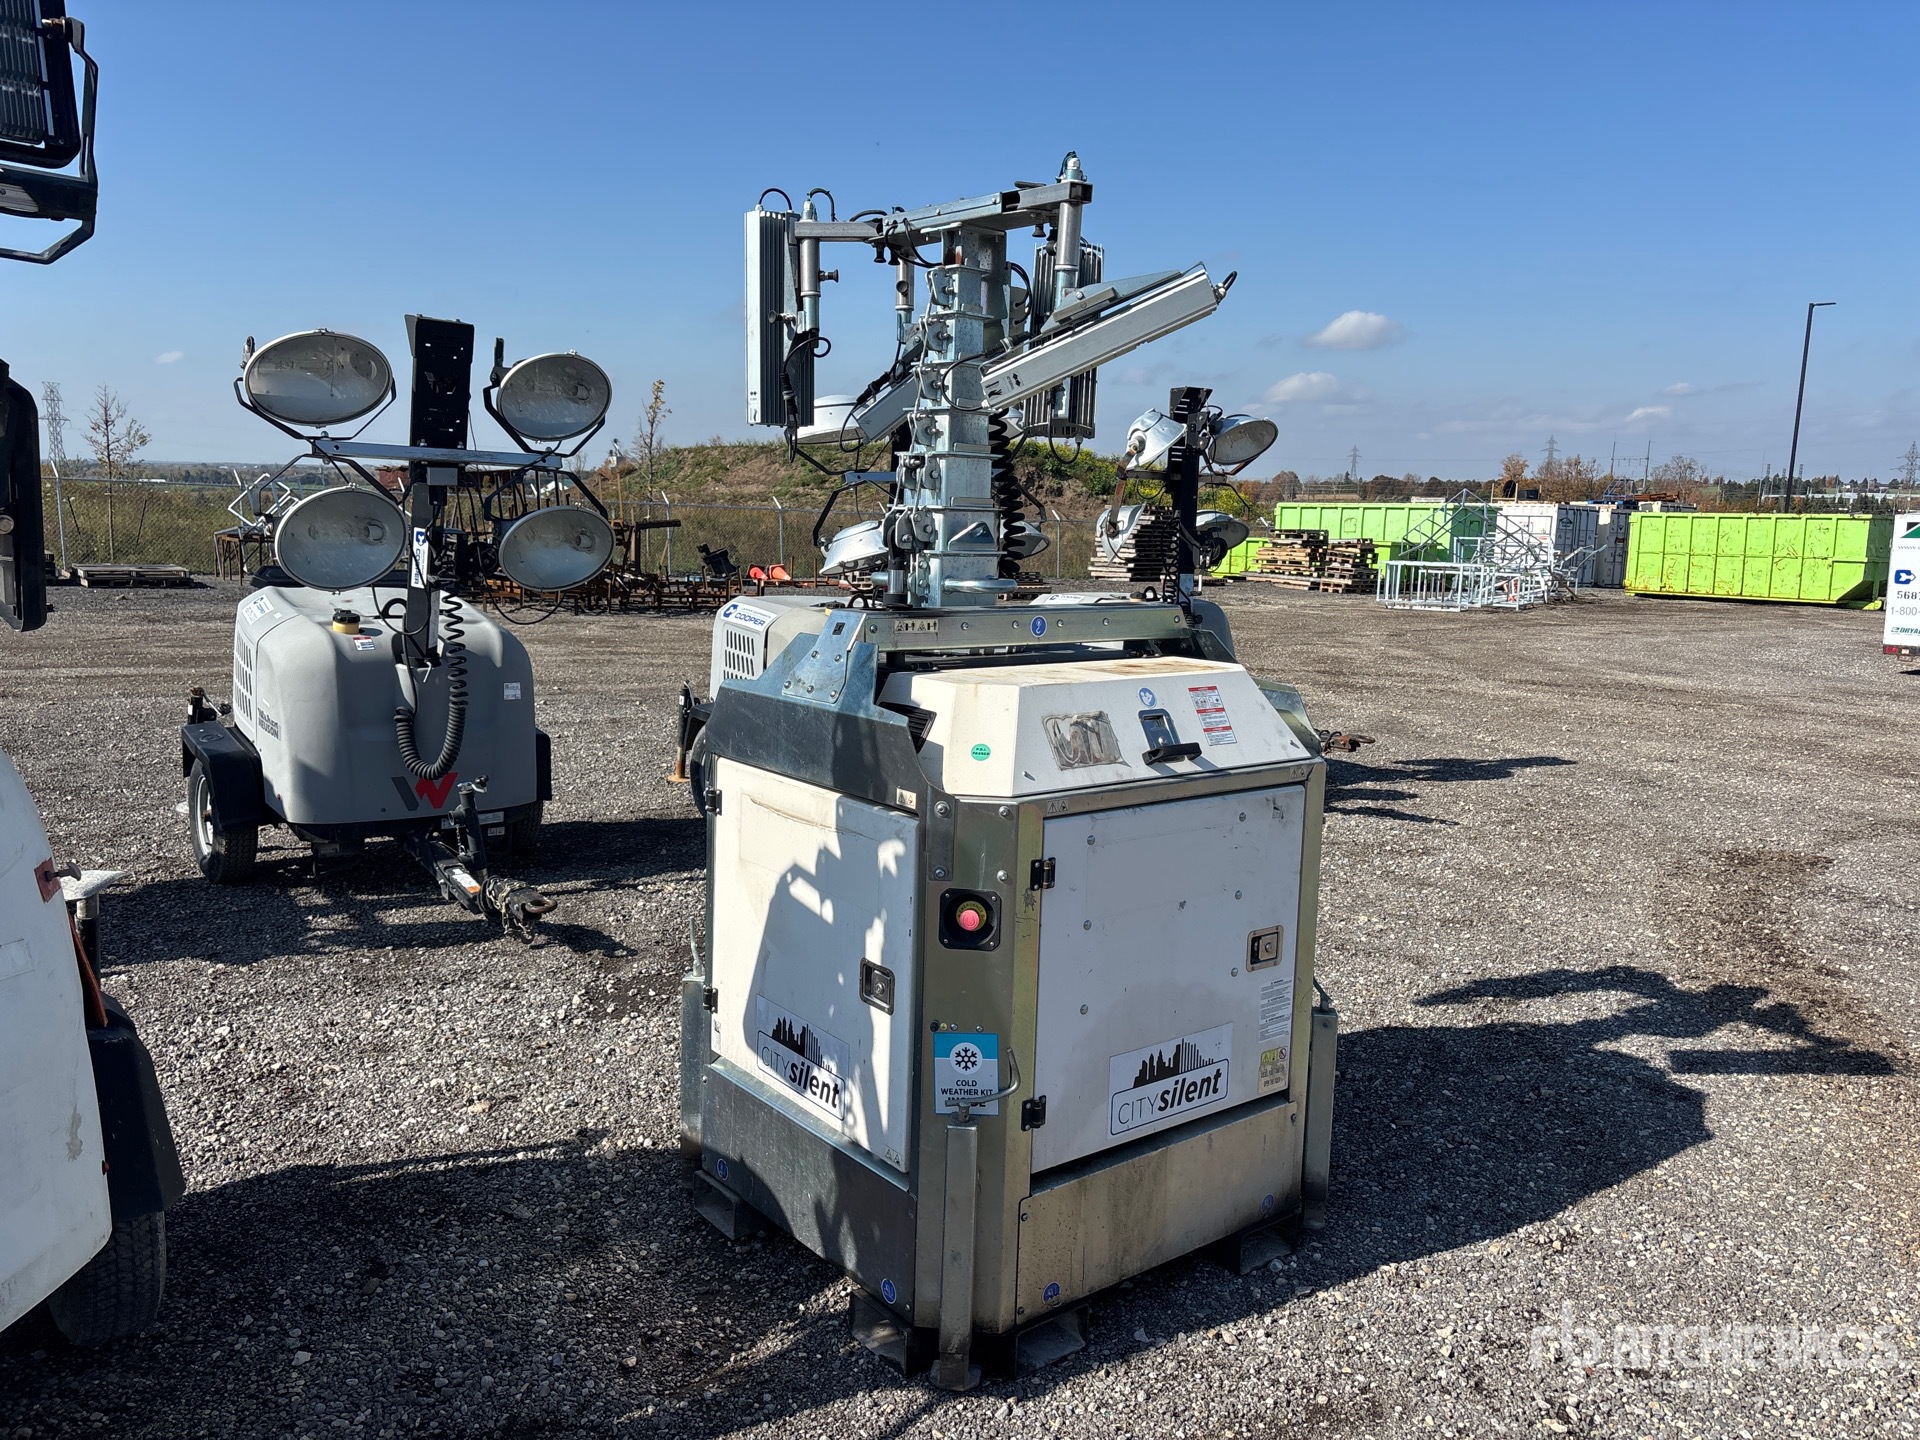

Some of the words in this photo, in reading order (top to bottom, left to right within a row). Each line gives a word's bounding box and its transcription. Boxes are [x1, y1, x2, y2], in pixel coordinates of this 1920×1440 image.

[1897, 590, 1920, 600] 568
[735, 612, 766, 626] COOPER
[955, 1079, 978, 1087] COLD
[940, 1087, 979, 1096] WEATHER
[980, 1088, 994, 1096] KIT
